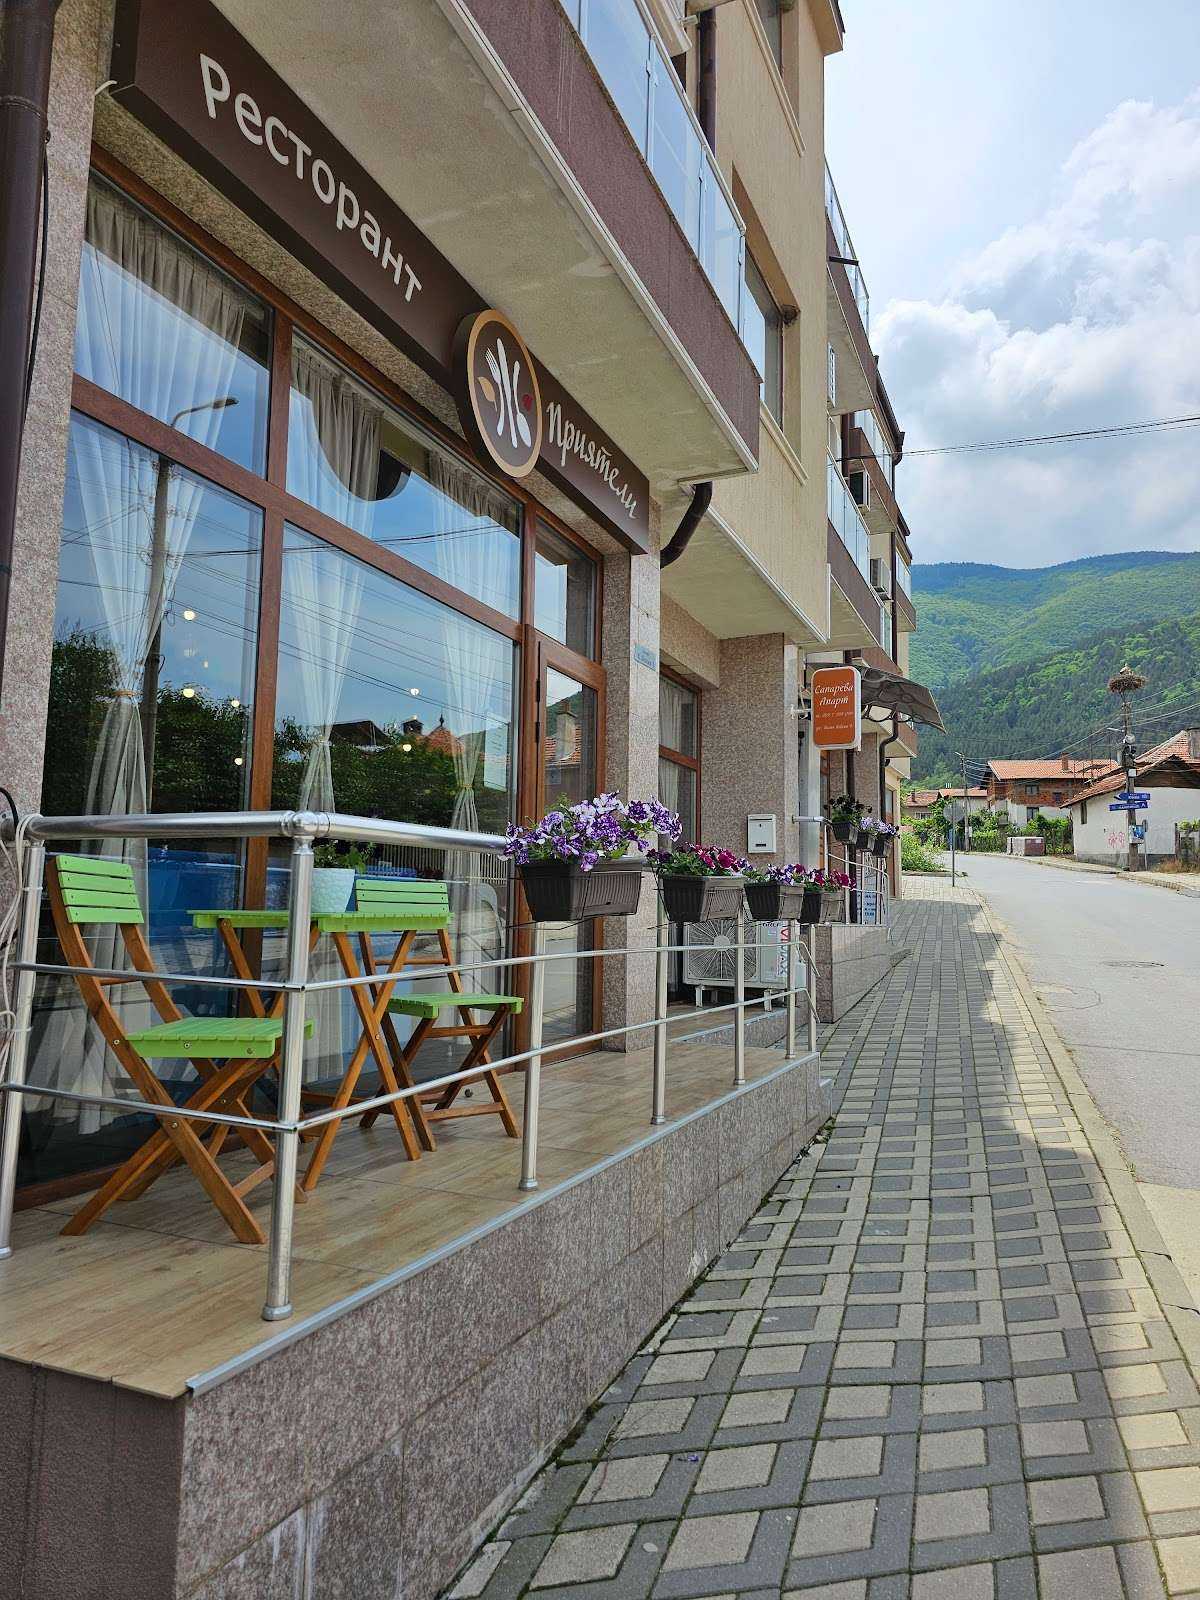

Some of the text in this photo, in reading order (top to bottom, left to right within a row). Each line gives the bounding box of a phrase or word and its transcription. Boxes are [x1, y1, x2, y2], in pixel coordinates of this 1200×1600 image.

[200, 53, 422, 302] Ресторант
[546, 402, 637, 519] Приятели
[815, 683, 853, 695] Сапарева
[820, 696, 848, 708] Апарт
